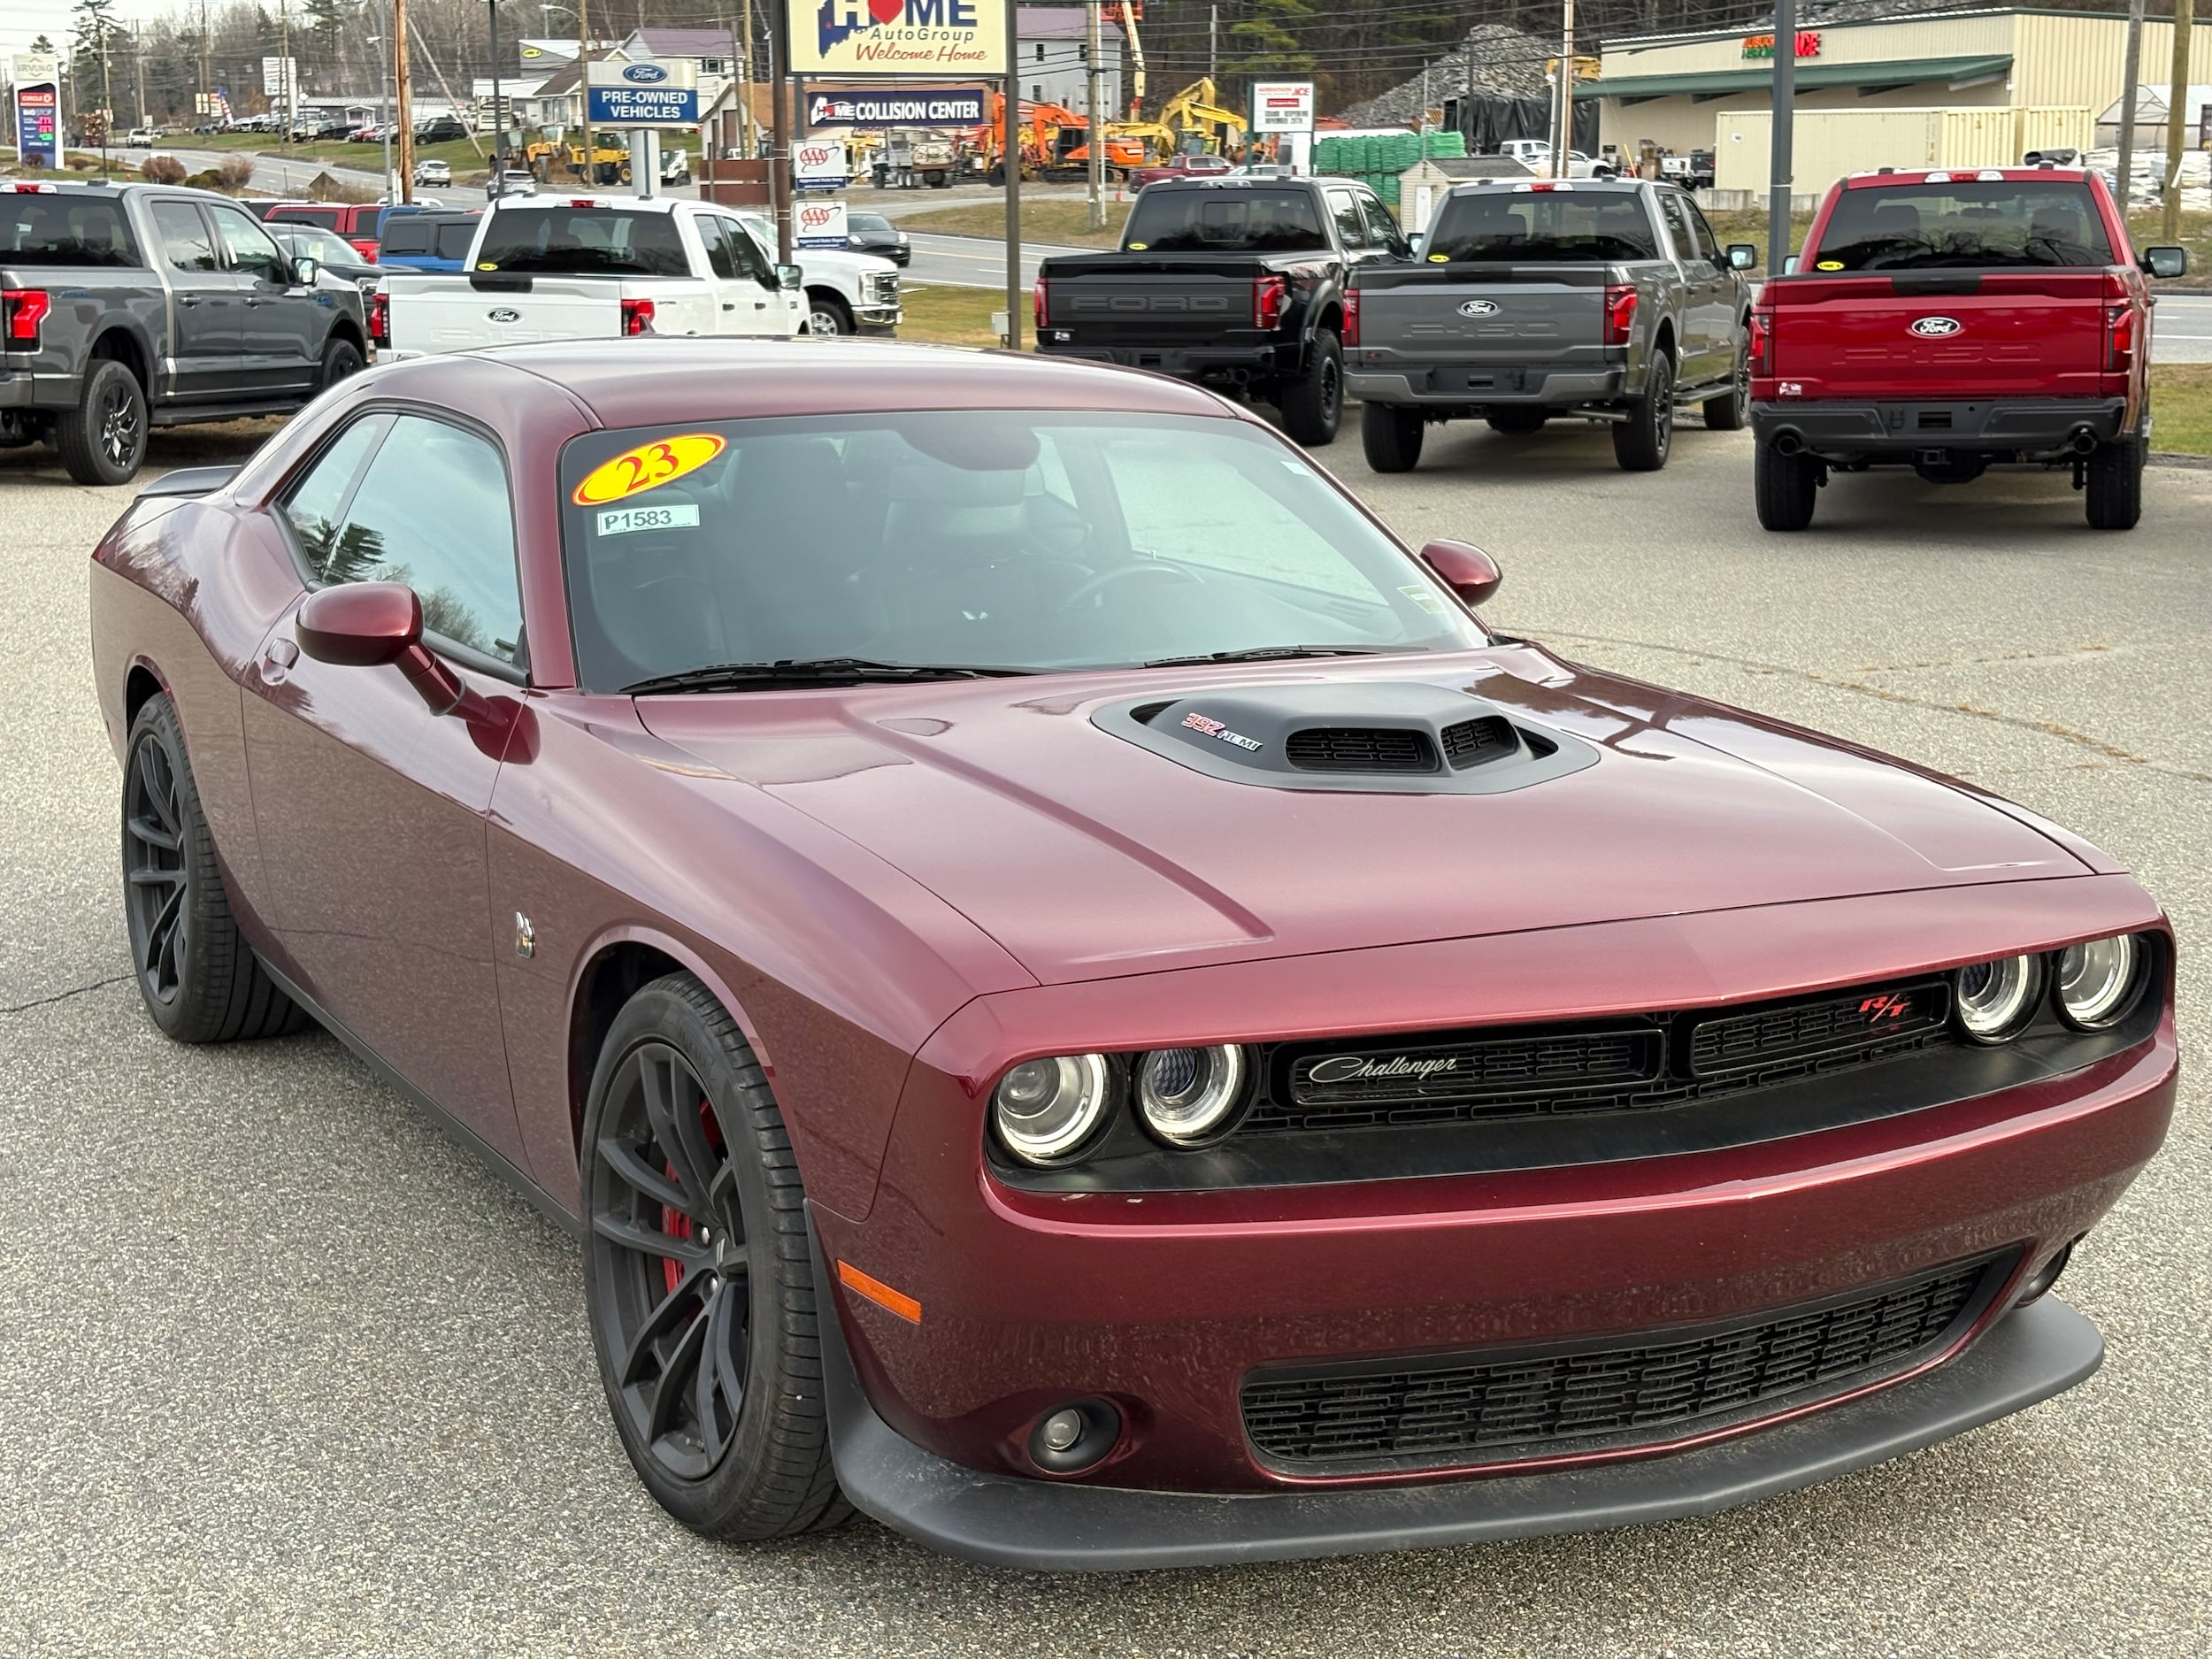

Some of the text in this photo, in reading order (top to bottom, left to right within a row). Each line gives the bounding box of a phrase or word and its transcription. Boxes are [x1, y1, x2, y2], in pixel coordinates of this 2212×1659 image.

[870, 27, 974, 43] AutoGroup
[856, 42, 987, 62] Welcome Home
[602, 90, 687, 104] PRE-OWNED
[611, 105, 680, 119] VEHICLES
[856, 101, 979, 120] COLLISION CENTER
[802, 149, 827, 165] AAA
[803, 209, 828, 226] AAA
[1070, 296, 1229, 311] FORD
[617, 443, 679, 493] 23
[604, 510, 672, 529] P1583
[1181, 712, 1263, 751] 392 HEMI
[1859, 993, 1911, 1023] R/T
[1309, 1056, 1457, 1083] Challenger
